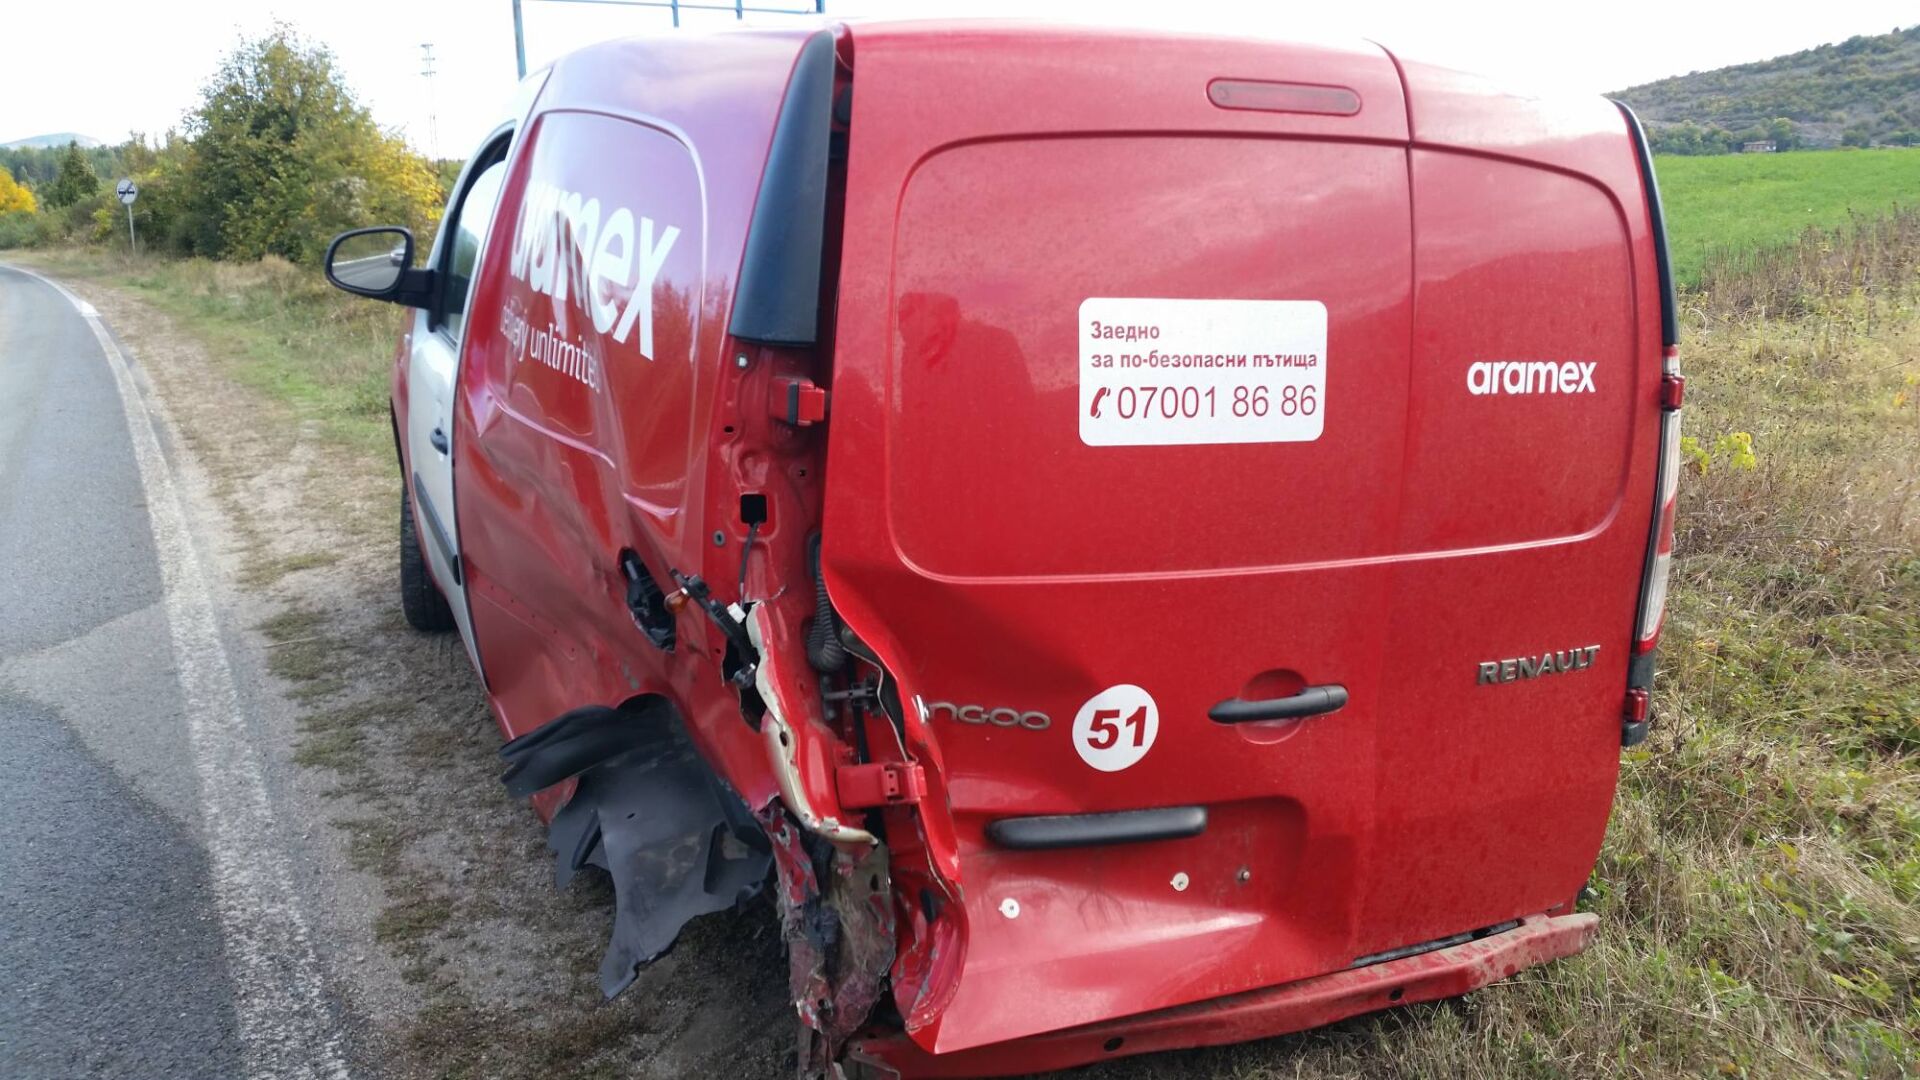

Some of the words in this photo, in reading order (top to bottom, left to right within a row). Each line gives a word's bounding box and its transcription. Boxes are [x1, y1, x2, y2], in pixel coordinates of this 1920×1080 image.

[1090, 320, 1160, 342] Заедно
[1091, 353, 1114, 368] за
[1120, 350, 1247, 369] по-безопасни
[1253, 353, 1317, 370] пътища
[1466, 360, 1597, 396] aramex
[1117, 386, 1217, 419] 07001
[1232, 385, 1269, 417] 86
[1281, 384, 1317, 416] 86
[1477, 644, 1601, 685] RENAULT
[1086, 705, 1148, 750] 51
